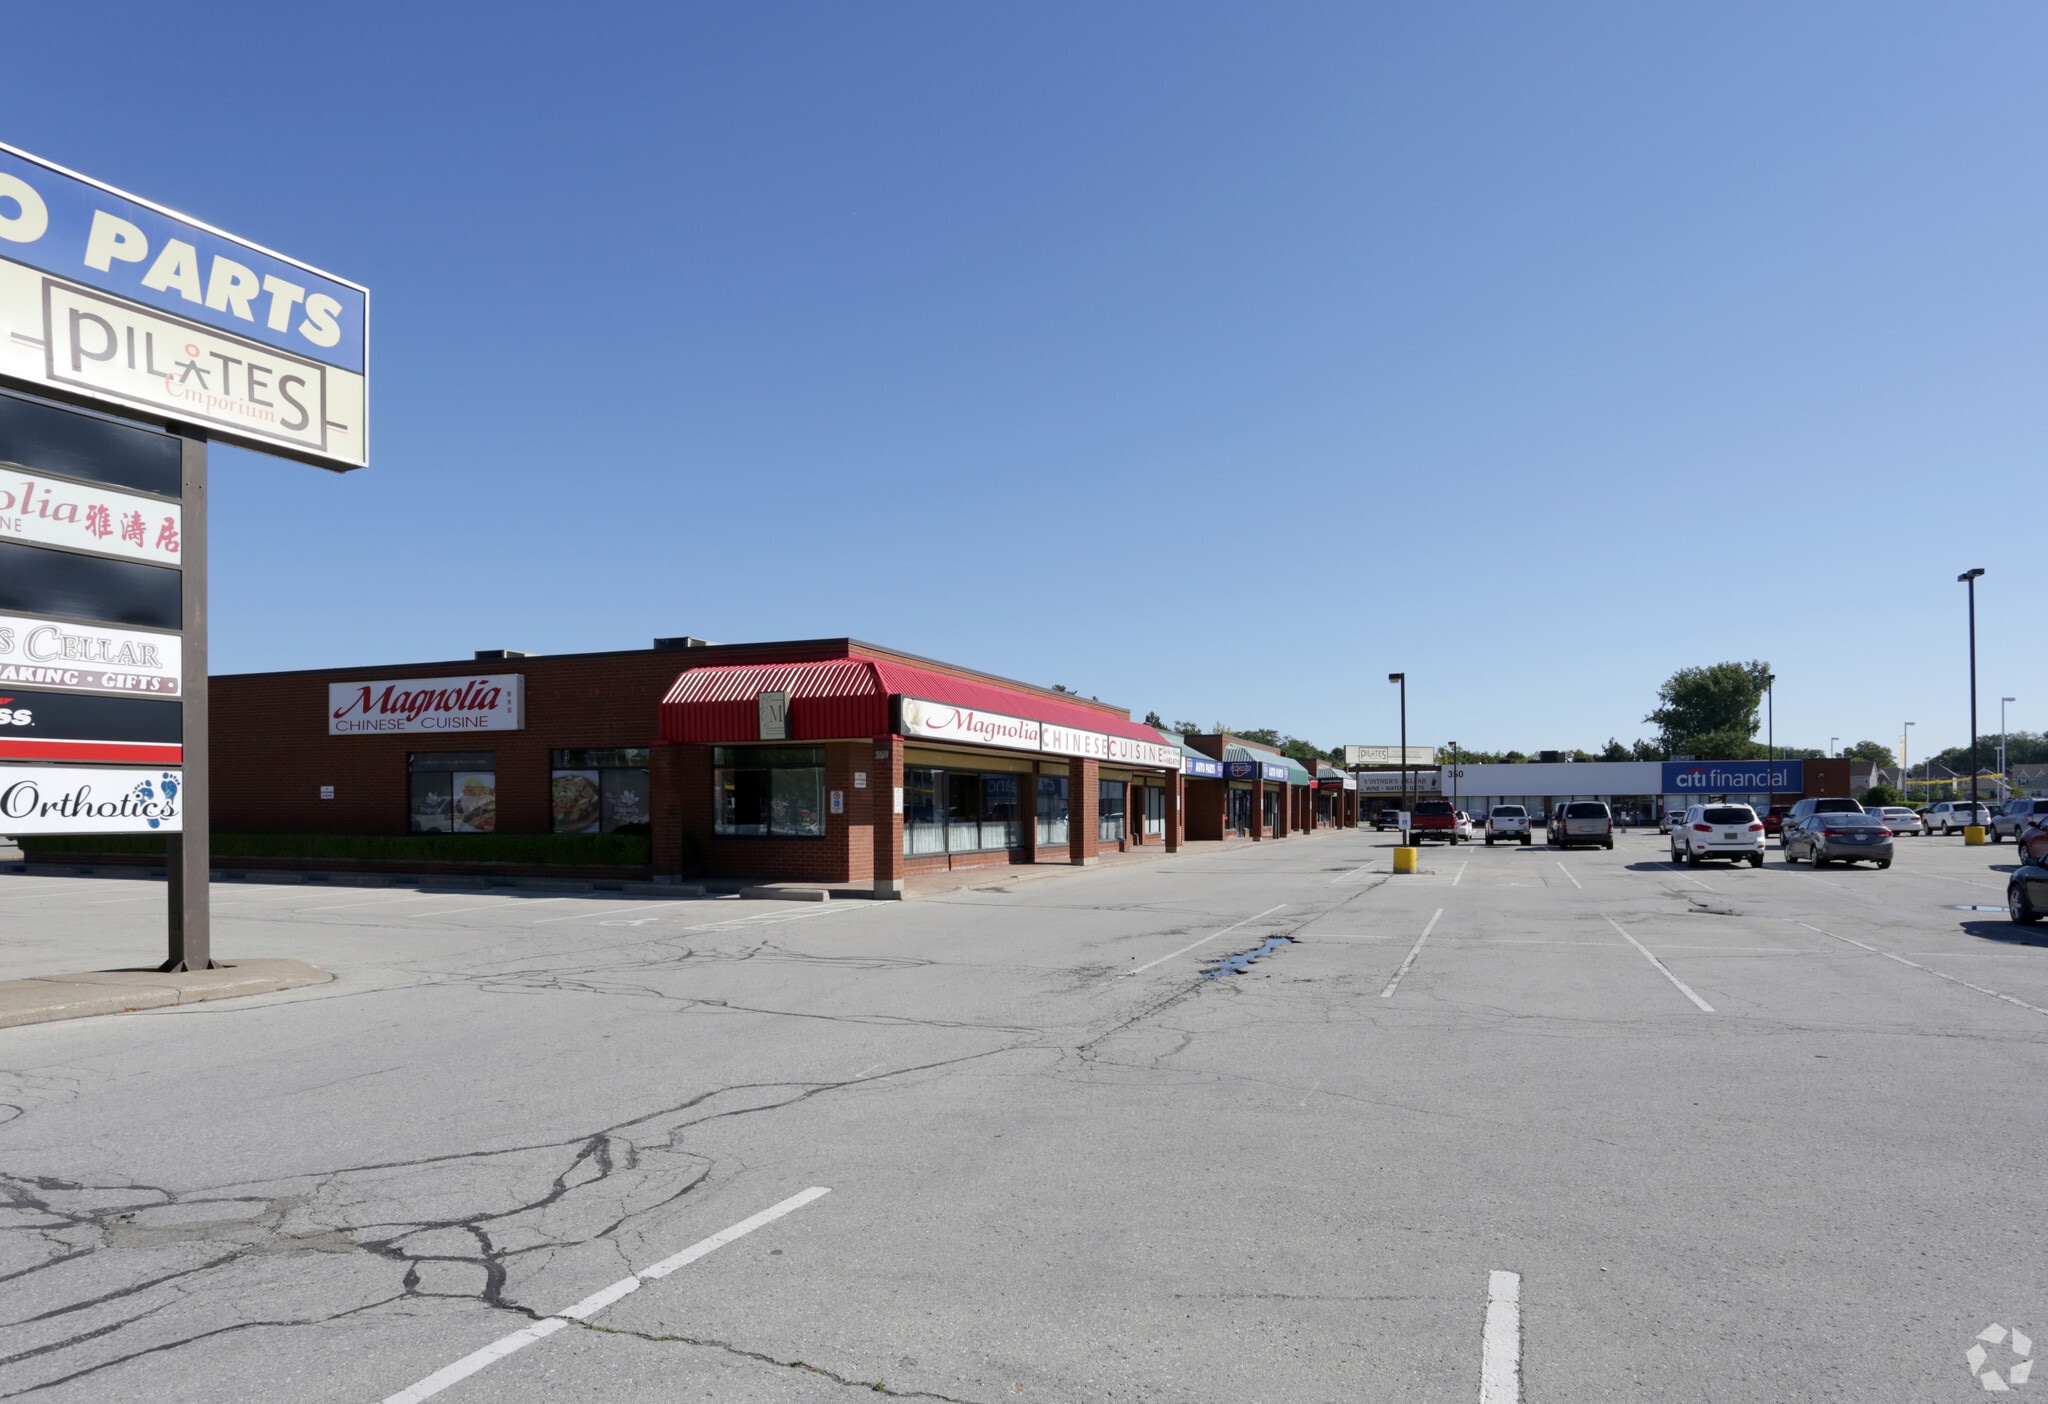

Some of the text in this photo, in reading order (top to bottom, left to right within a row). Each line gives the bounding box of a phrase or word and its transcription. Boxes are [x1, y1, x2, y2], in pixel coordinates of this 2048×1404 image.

[84, 209, 343, 347] PARTS
[164, 372, 277, 423] Emporium
[23, 624, 162, 669] CELLAR
[0, 664, 161, 690] AKING GIFTS
[333, 679, 502, 722] Magnolia
[335, 715, 488, 731] CHINESE CUISINE
[925, 707, 1038, 742] Magnolia
[1041, 727, 1163, 762] CHINESE CUISINE
[1676, 768, 1787, 787] citi financial
[0, 780, 179, 819] Orthotics
